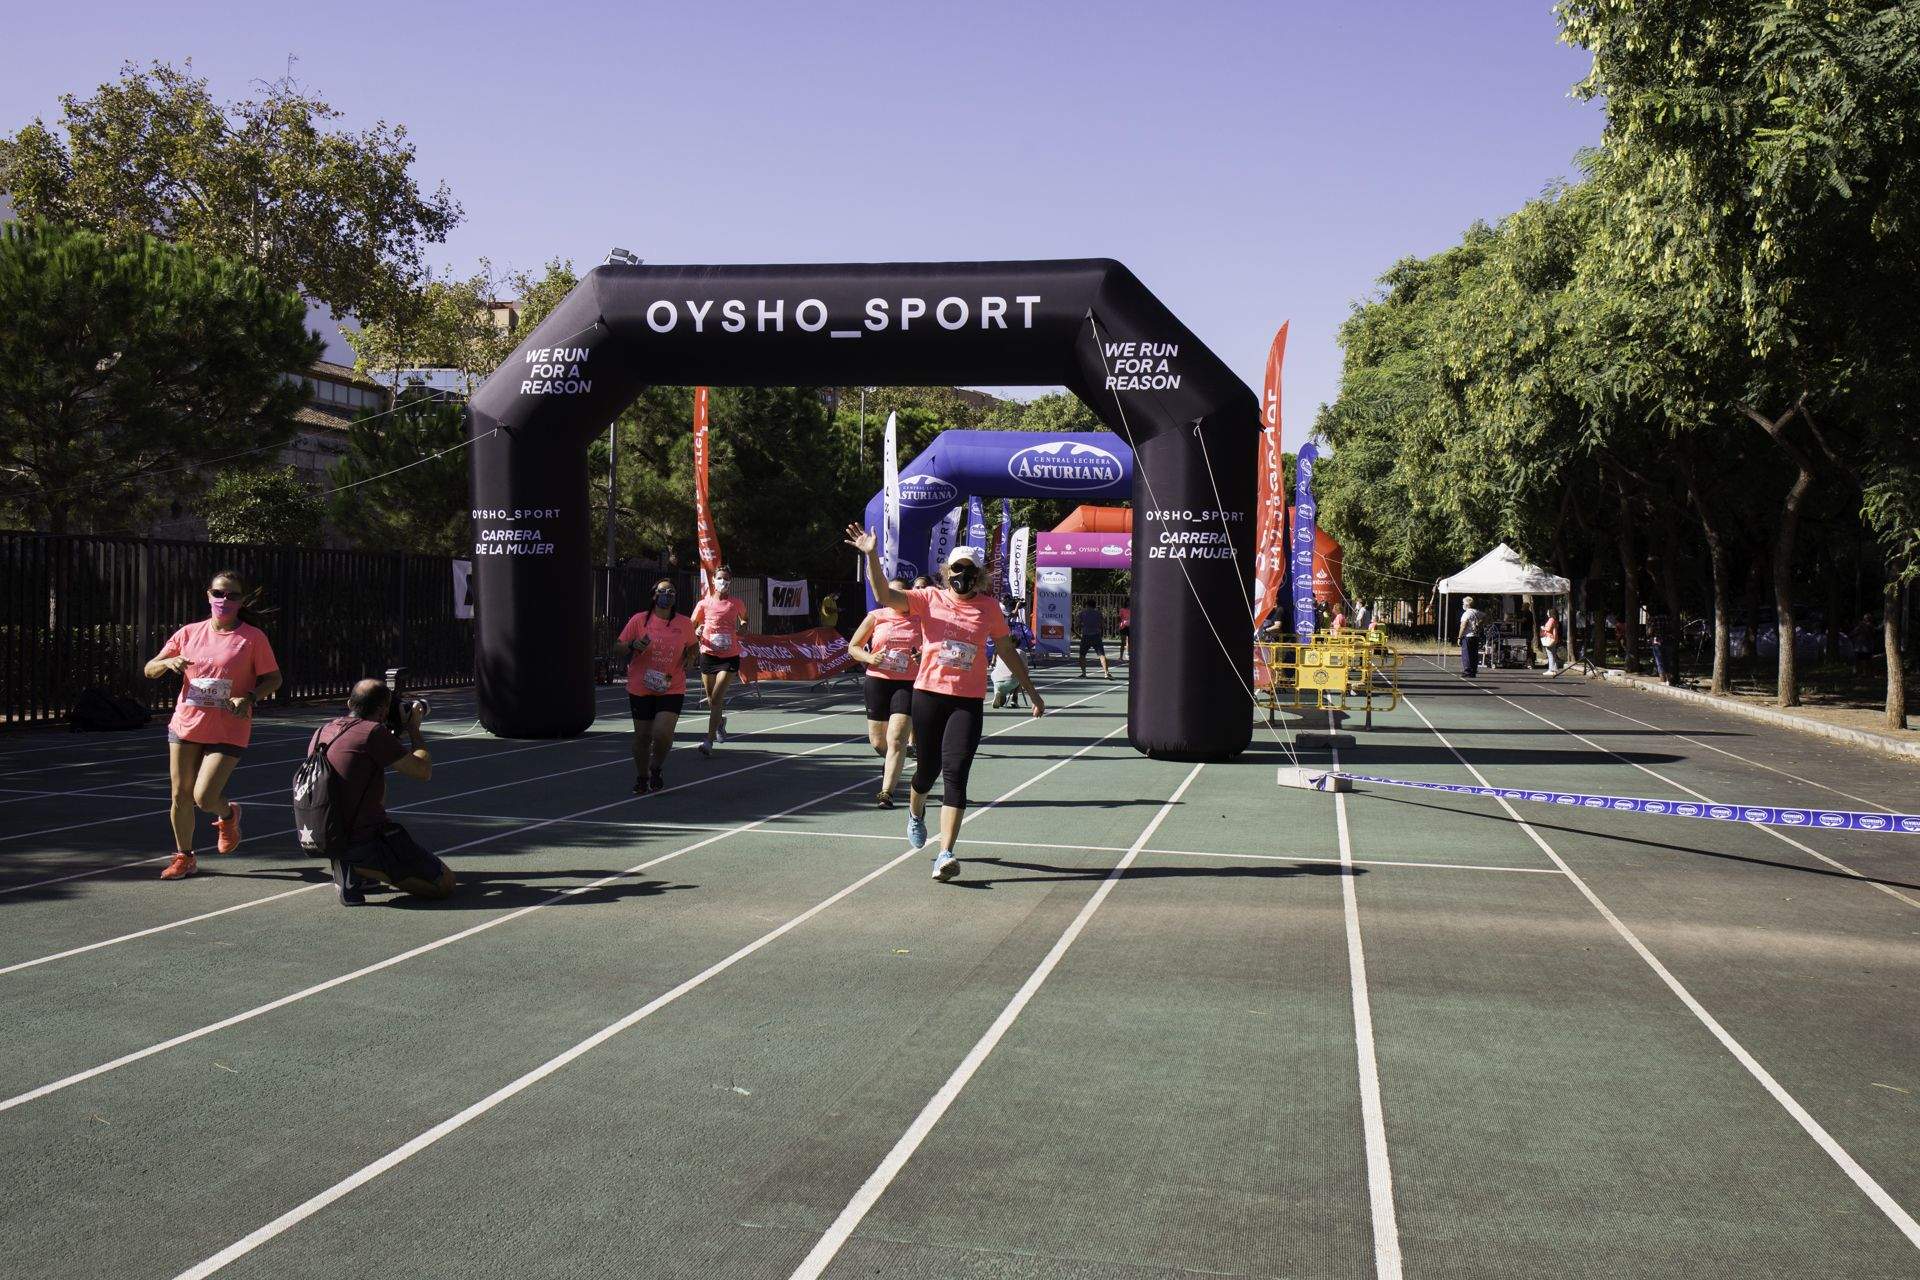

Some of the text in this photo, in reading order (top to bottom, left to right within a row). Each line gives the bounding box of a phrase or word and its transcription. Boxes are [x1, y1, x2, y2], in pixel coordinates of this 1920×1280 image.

[646, 295, 1041, 338] OYSHO_SPORT
[526, 348, 589, 362] WE RUN
[1105, 342, 1178, 357] WE RUN
[530, 364, 580, 378] FOR A
[1114, 358, 1169, 374] FOR A
[520, 380, 592, 394] REASON
[1105, 375, 1181, 391] REASON
[1073, 457, 1110, 465] LECHERA
[1018, 457, 1114, 480] ASTURIANA
[899, 490, 951, 501] STURIANA
[472, 509, 560, 521] OYSHO_SPORT
[1146, 511, 1244, 523] OYSHO_SPORT
[481, 530, 541, 541] CARRERA
[1160, 531, 1227, 544] CARRERA
[475, 543, 554, 555] DE LA MUJER
[1149, 546, 1238, 559] DE LA MUJER
